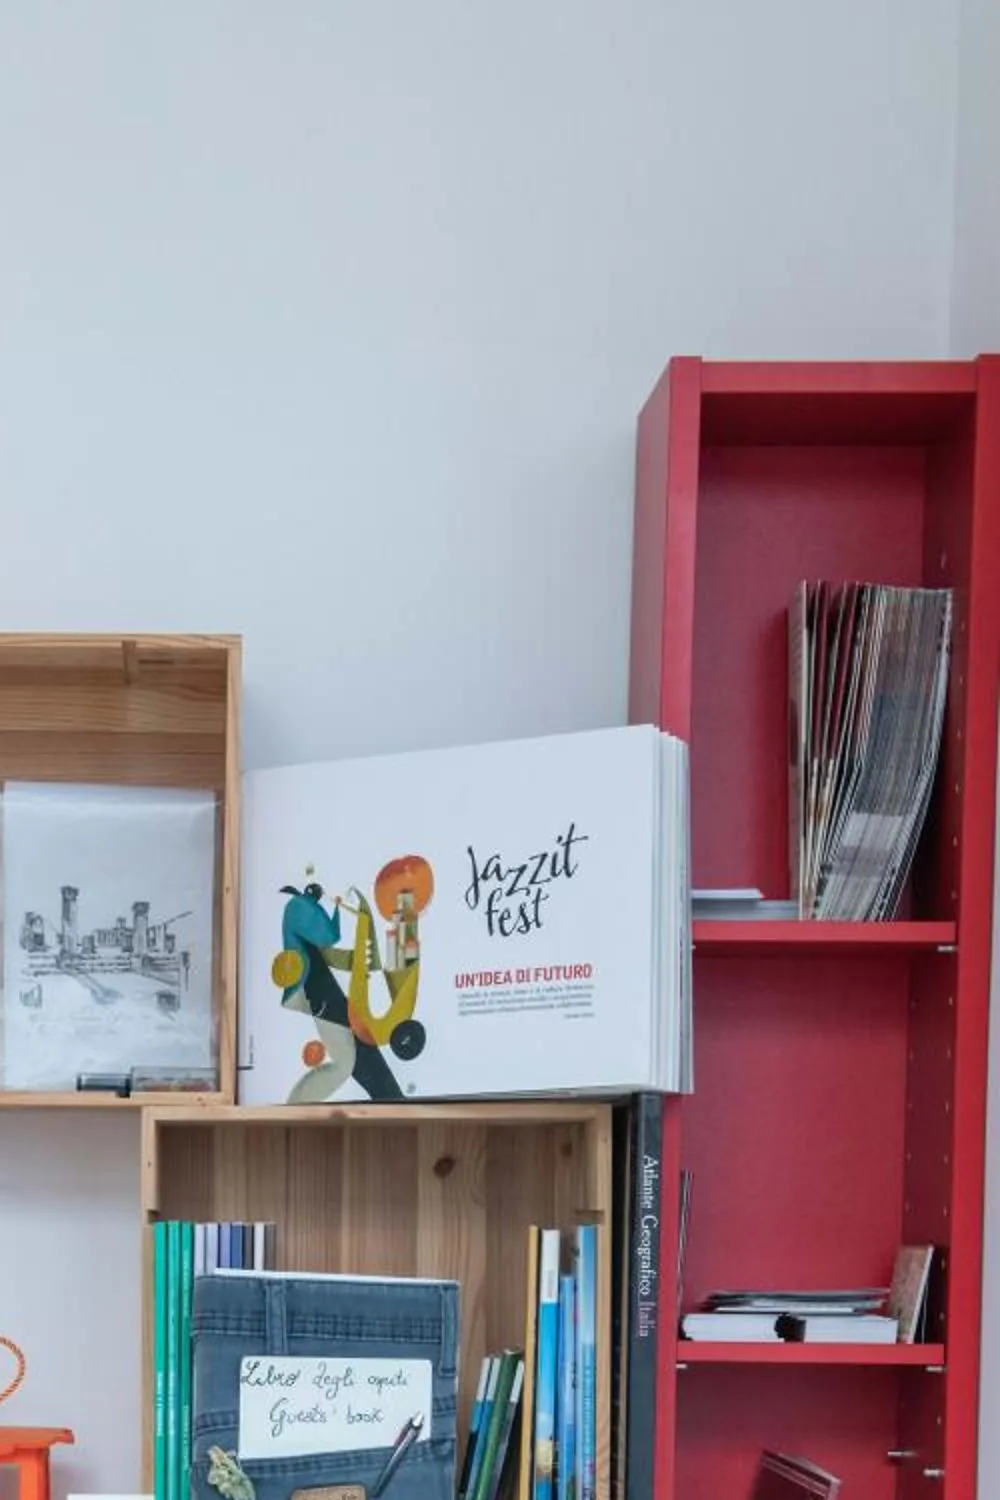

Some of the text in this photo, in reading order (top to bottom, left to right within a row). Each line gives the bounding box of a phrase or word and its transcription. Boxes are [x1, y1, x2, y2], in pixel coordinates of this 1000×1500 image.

[484, 887, 550, 937] fest
[455, 963, 593, 989] UN'IDEA DI FUTURO
[641, 1154, 660, 1210] Atlante
[637, 1214, 660, 1295] Geografico
[240, 1360, 301, 1386] Libro
[312, 1361, 355, 1400] degli
[346, 1403, 386, 1425] book
